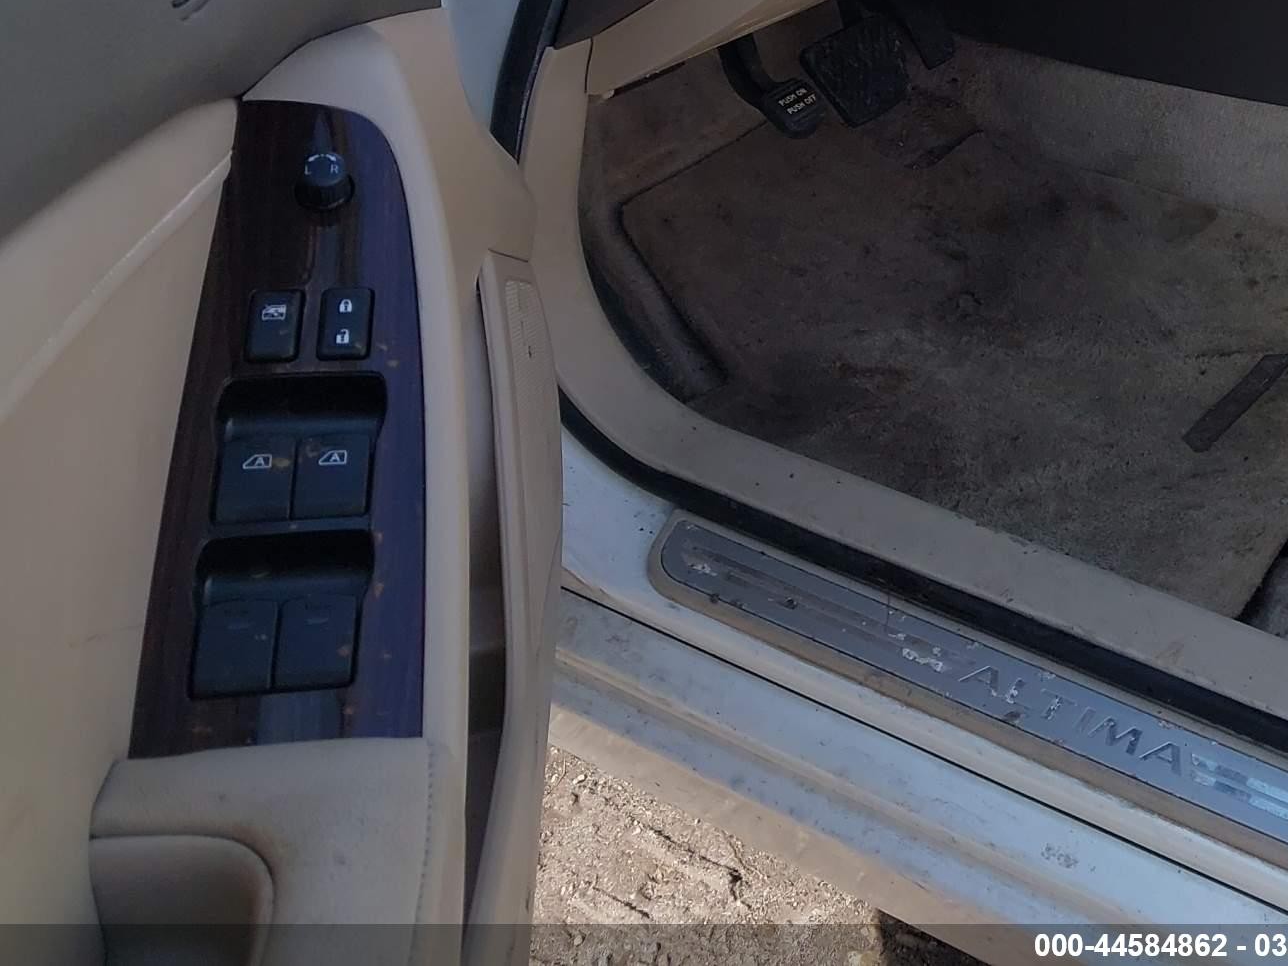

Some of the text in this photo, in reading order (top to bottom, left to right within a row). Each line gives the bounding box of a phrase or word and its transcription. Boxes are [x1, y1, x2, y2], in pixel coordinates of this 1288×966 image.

[778, 93, 797, 107] PUSH
[786, 93, 817, 115] PUSH OFF
[331, 165, 339, 175] R
[957, 665, 1182, 777] ALTIMA
